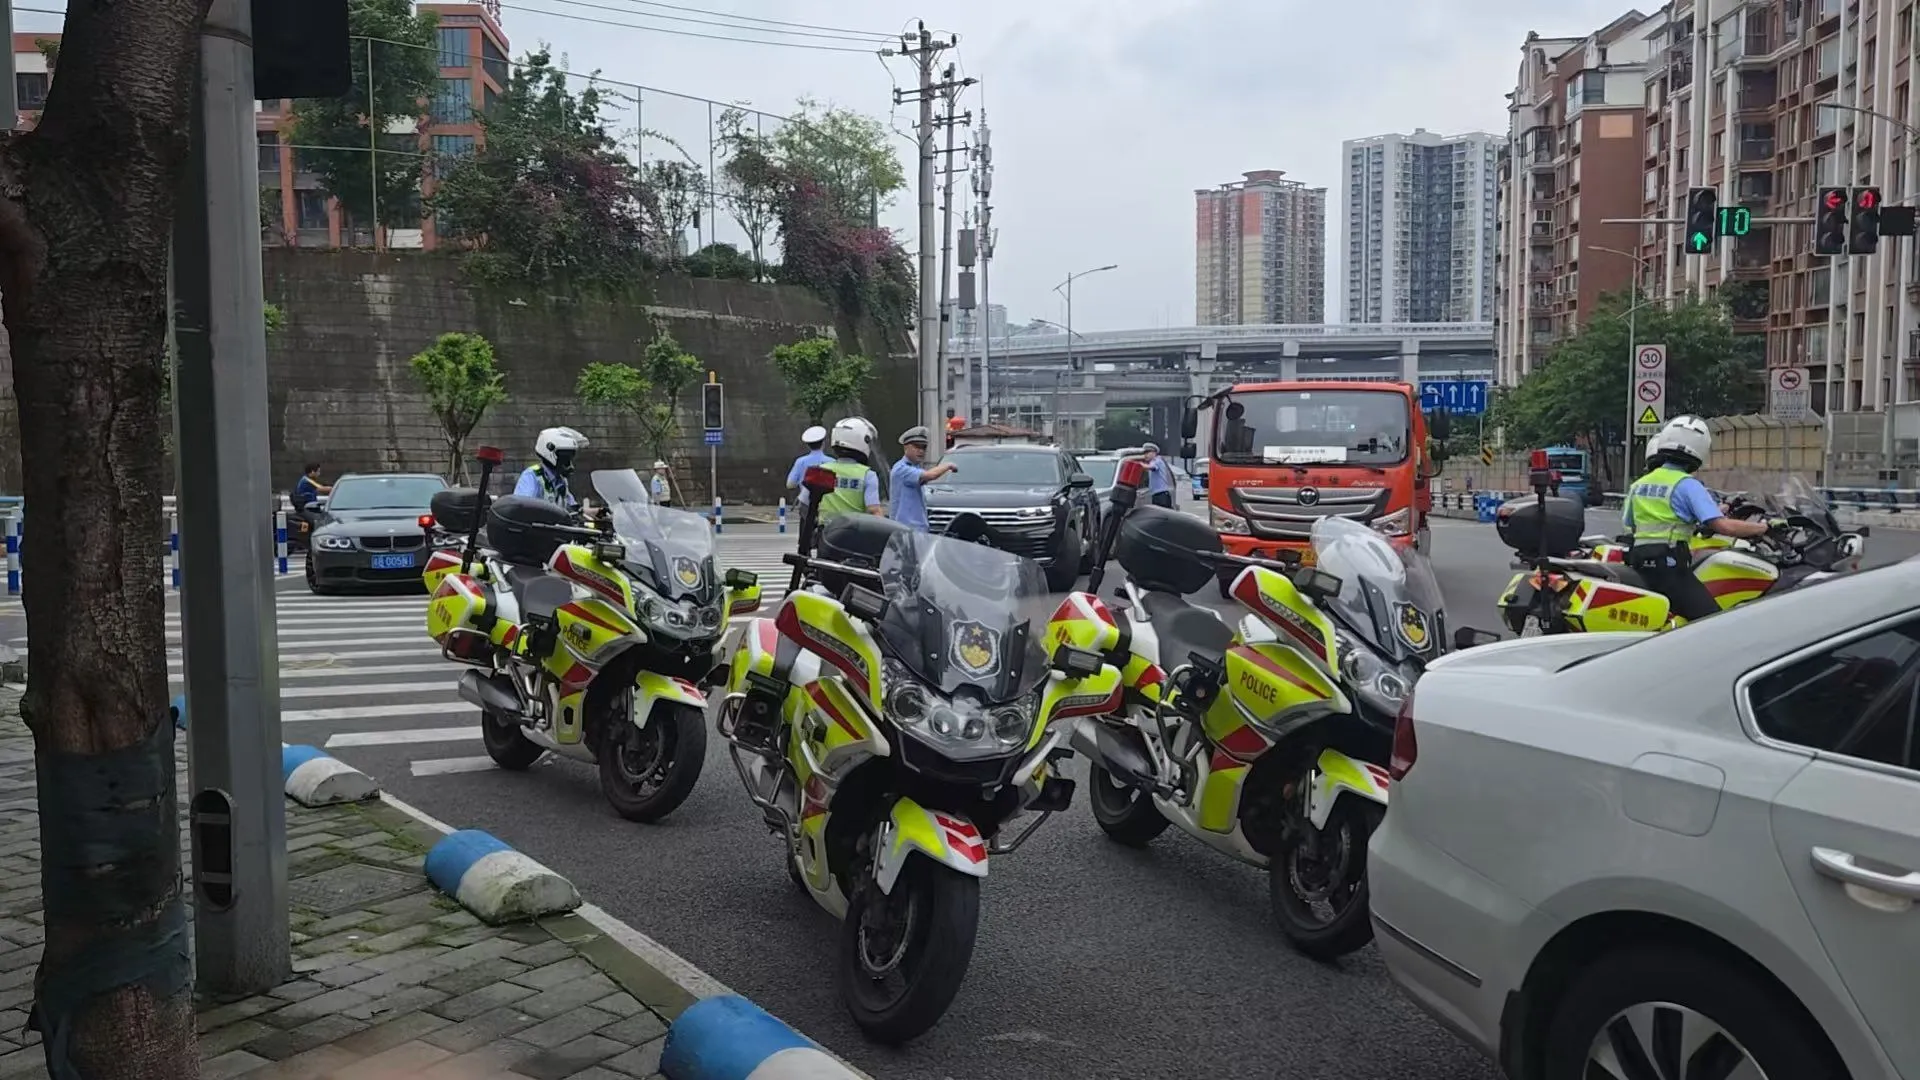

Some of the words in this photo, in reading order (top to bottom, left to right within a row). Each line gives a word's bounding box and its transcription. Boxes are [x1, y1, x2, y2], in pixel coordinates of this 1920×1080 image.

[1720, 208, 1749, 235] 10
[1644, 353, 1658, 363] 30
[1240, 671, 1278, 704] POLICE
